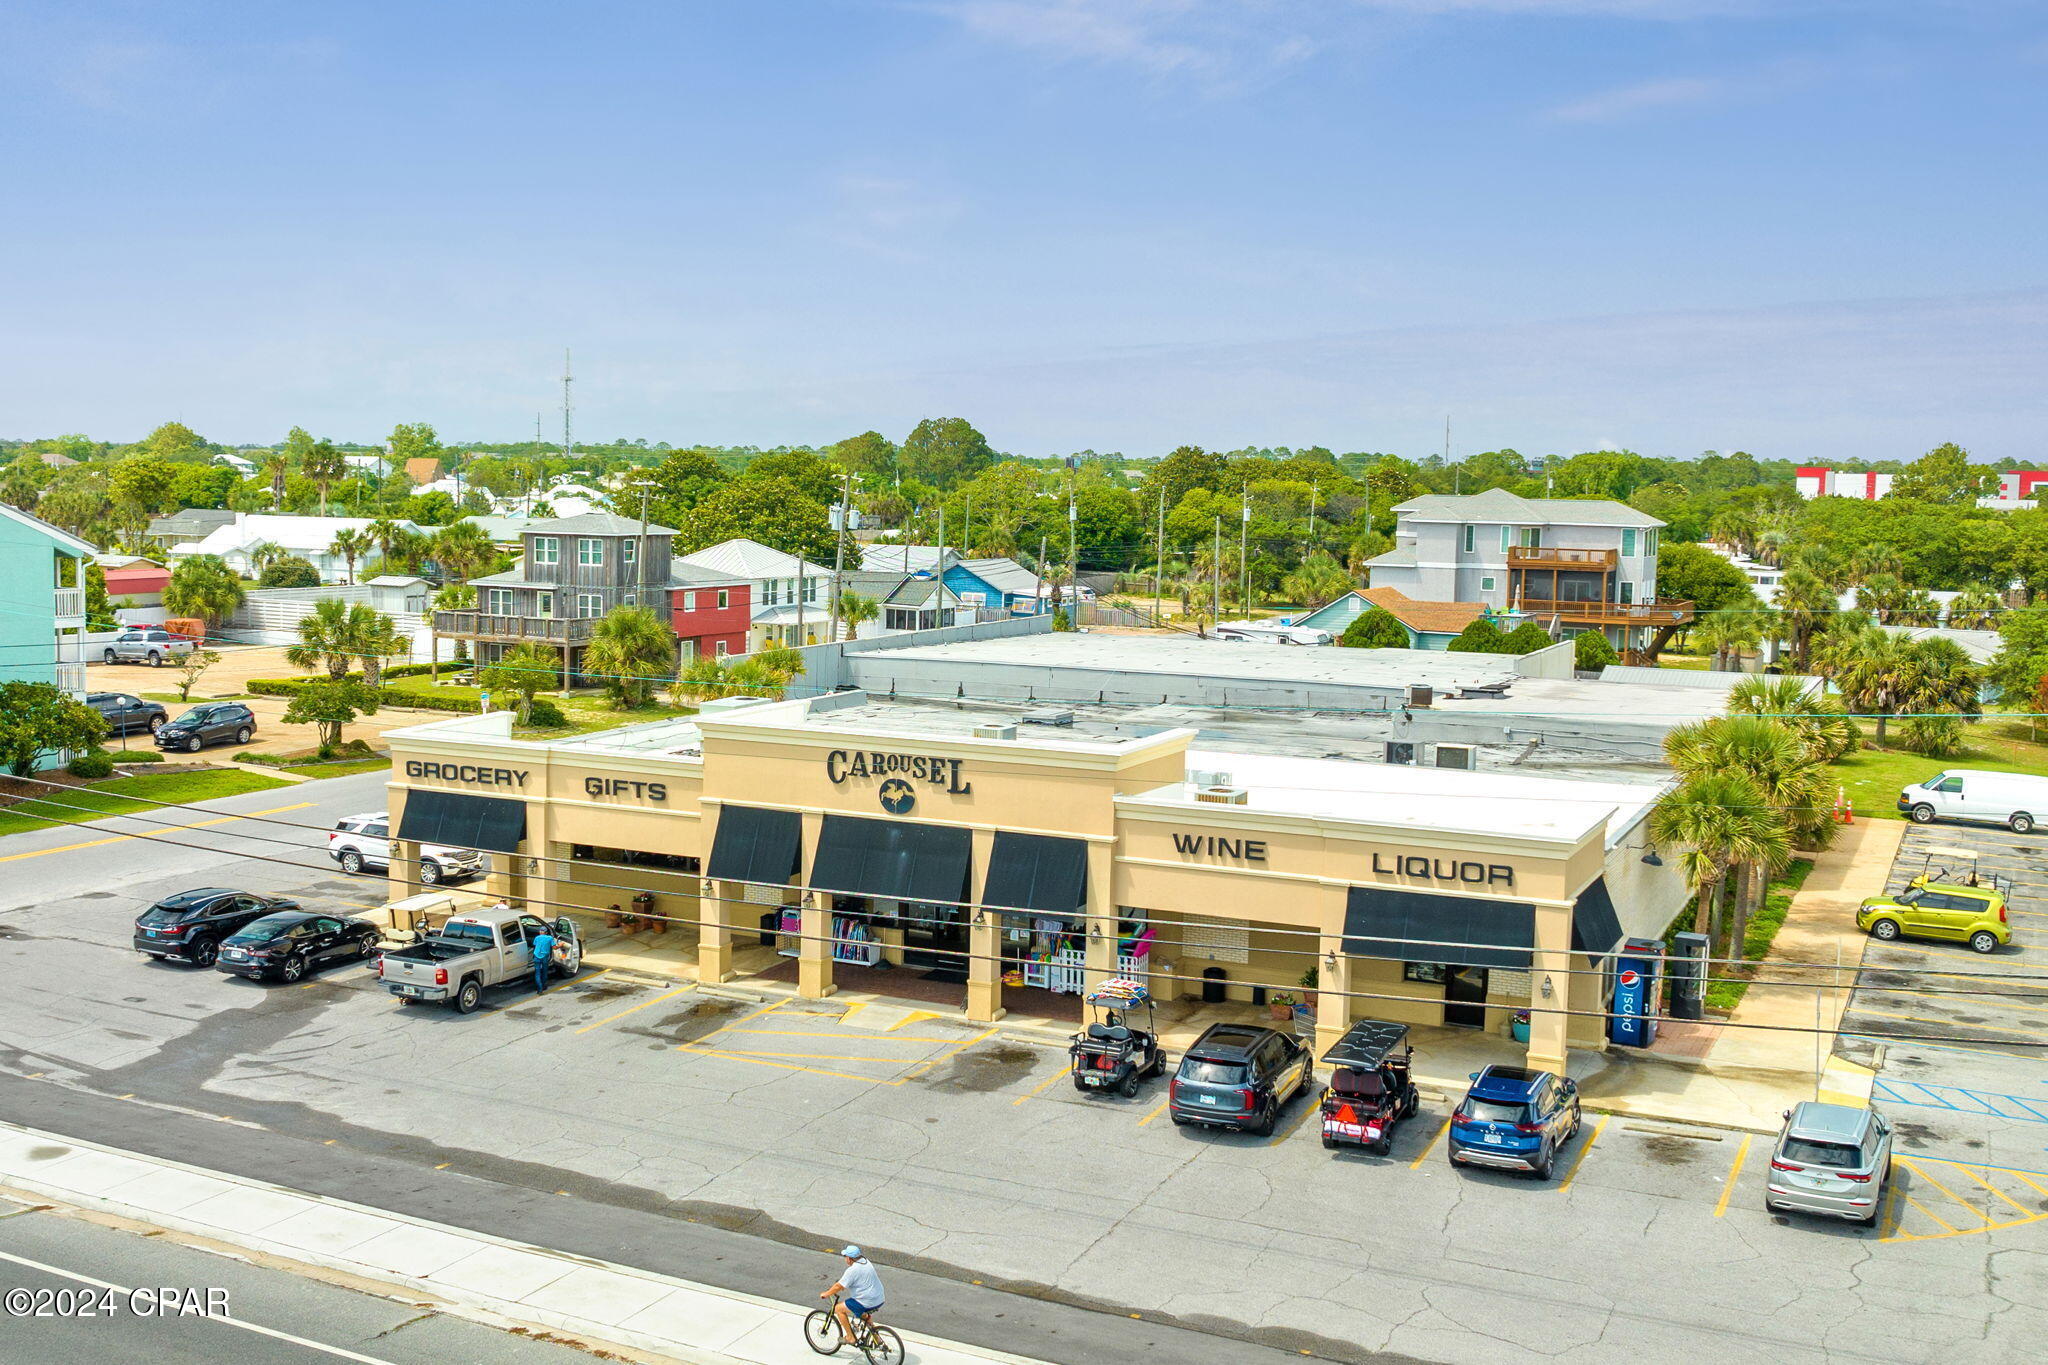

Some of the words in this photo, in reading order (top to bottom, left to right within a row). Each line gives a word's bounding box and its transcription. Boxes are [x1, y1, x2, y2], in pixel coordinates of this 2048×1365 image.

[406, 760, 529, 787] GROCERY
[827, 750, 971, 795] CAROUSEL
[585, 777, 667, 801] GIFTS
[1172, 833, 1267, 861] WINE
[1372, 853, 1514, 887] LIQUOR
